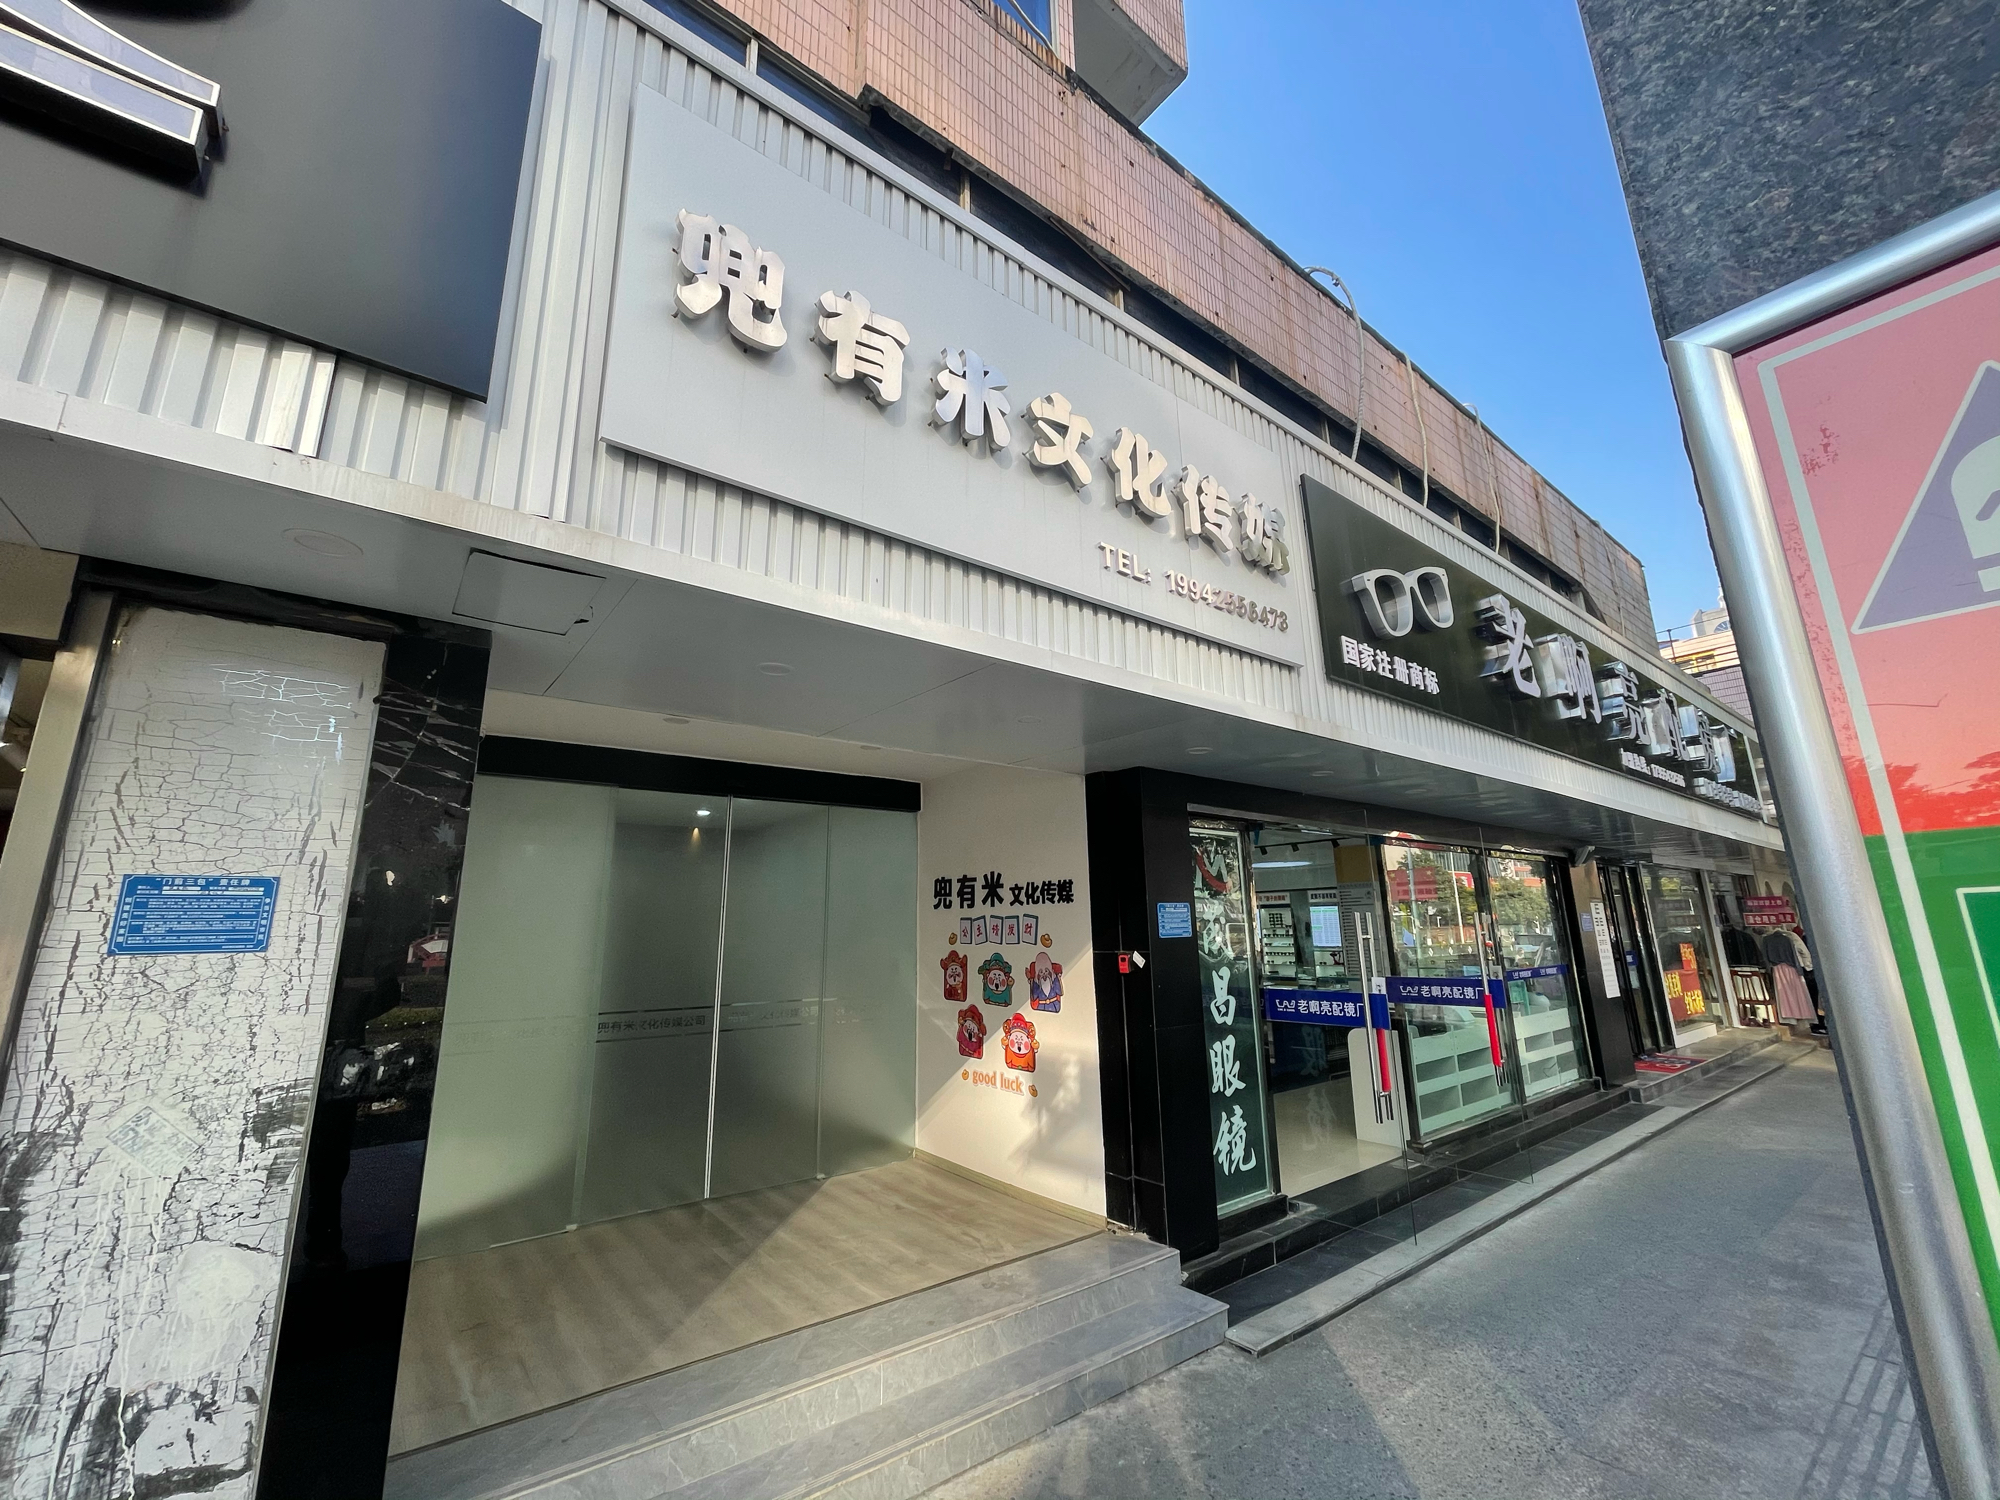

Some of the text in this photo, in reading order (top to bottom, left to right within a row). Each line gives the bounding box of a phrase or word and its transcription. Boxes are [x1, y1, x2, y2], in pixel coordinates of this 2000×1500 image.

[673, 208, 1290, 577] 兜有米文化传媒
[1341, 635, 1440, 695] 国家注册商标
[933, 871, 1074, 910] 兜有米文化传媒
[1420, 985, 1484, 999] 老啊亮配镜厂
[1297, 1000, 1364, 1017] 老啊亮配镜厂
[972, 1069, 1024, 1094] good luck
